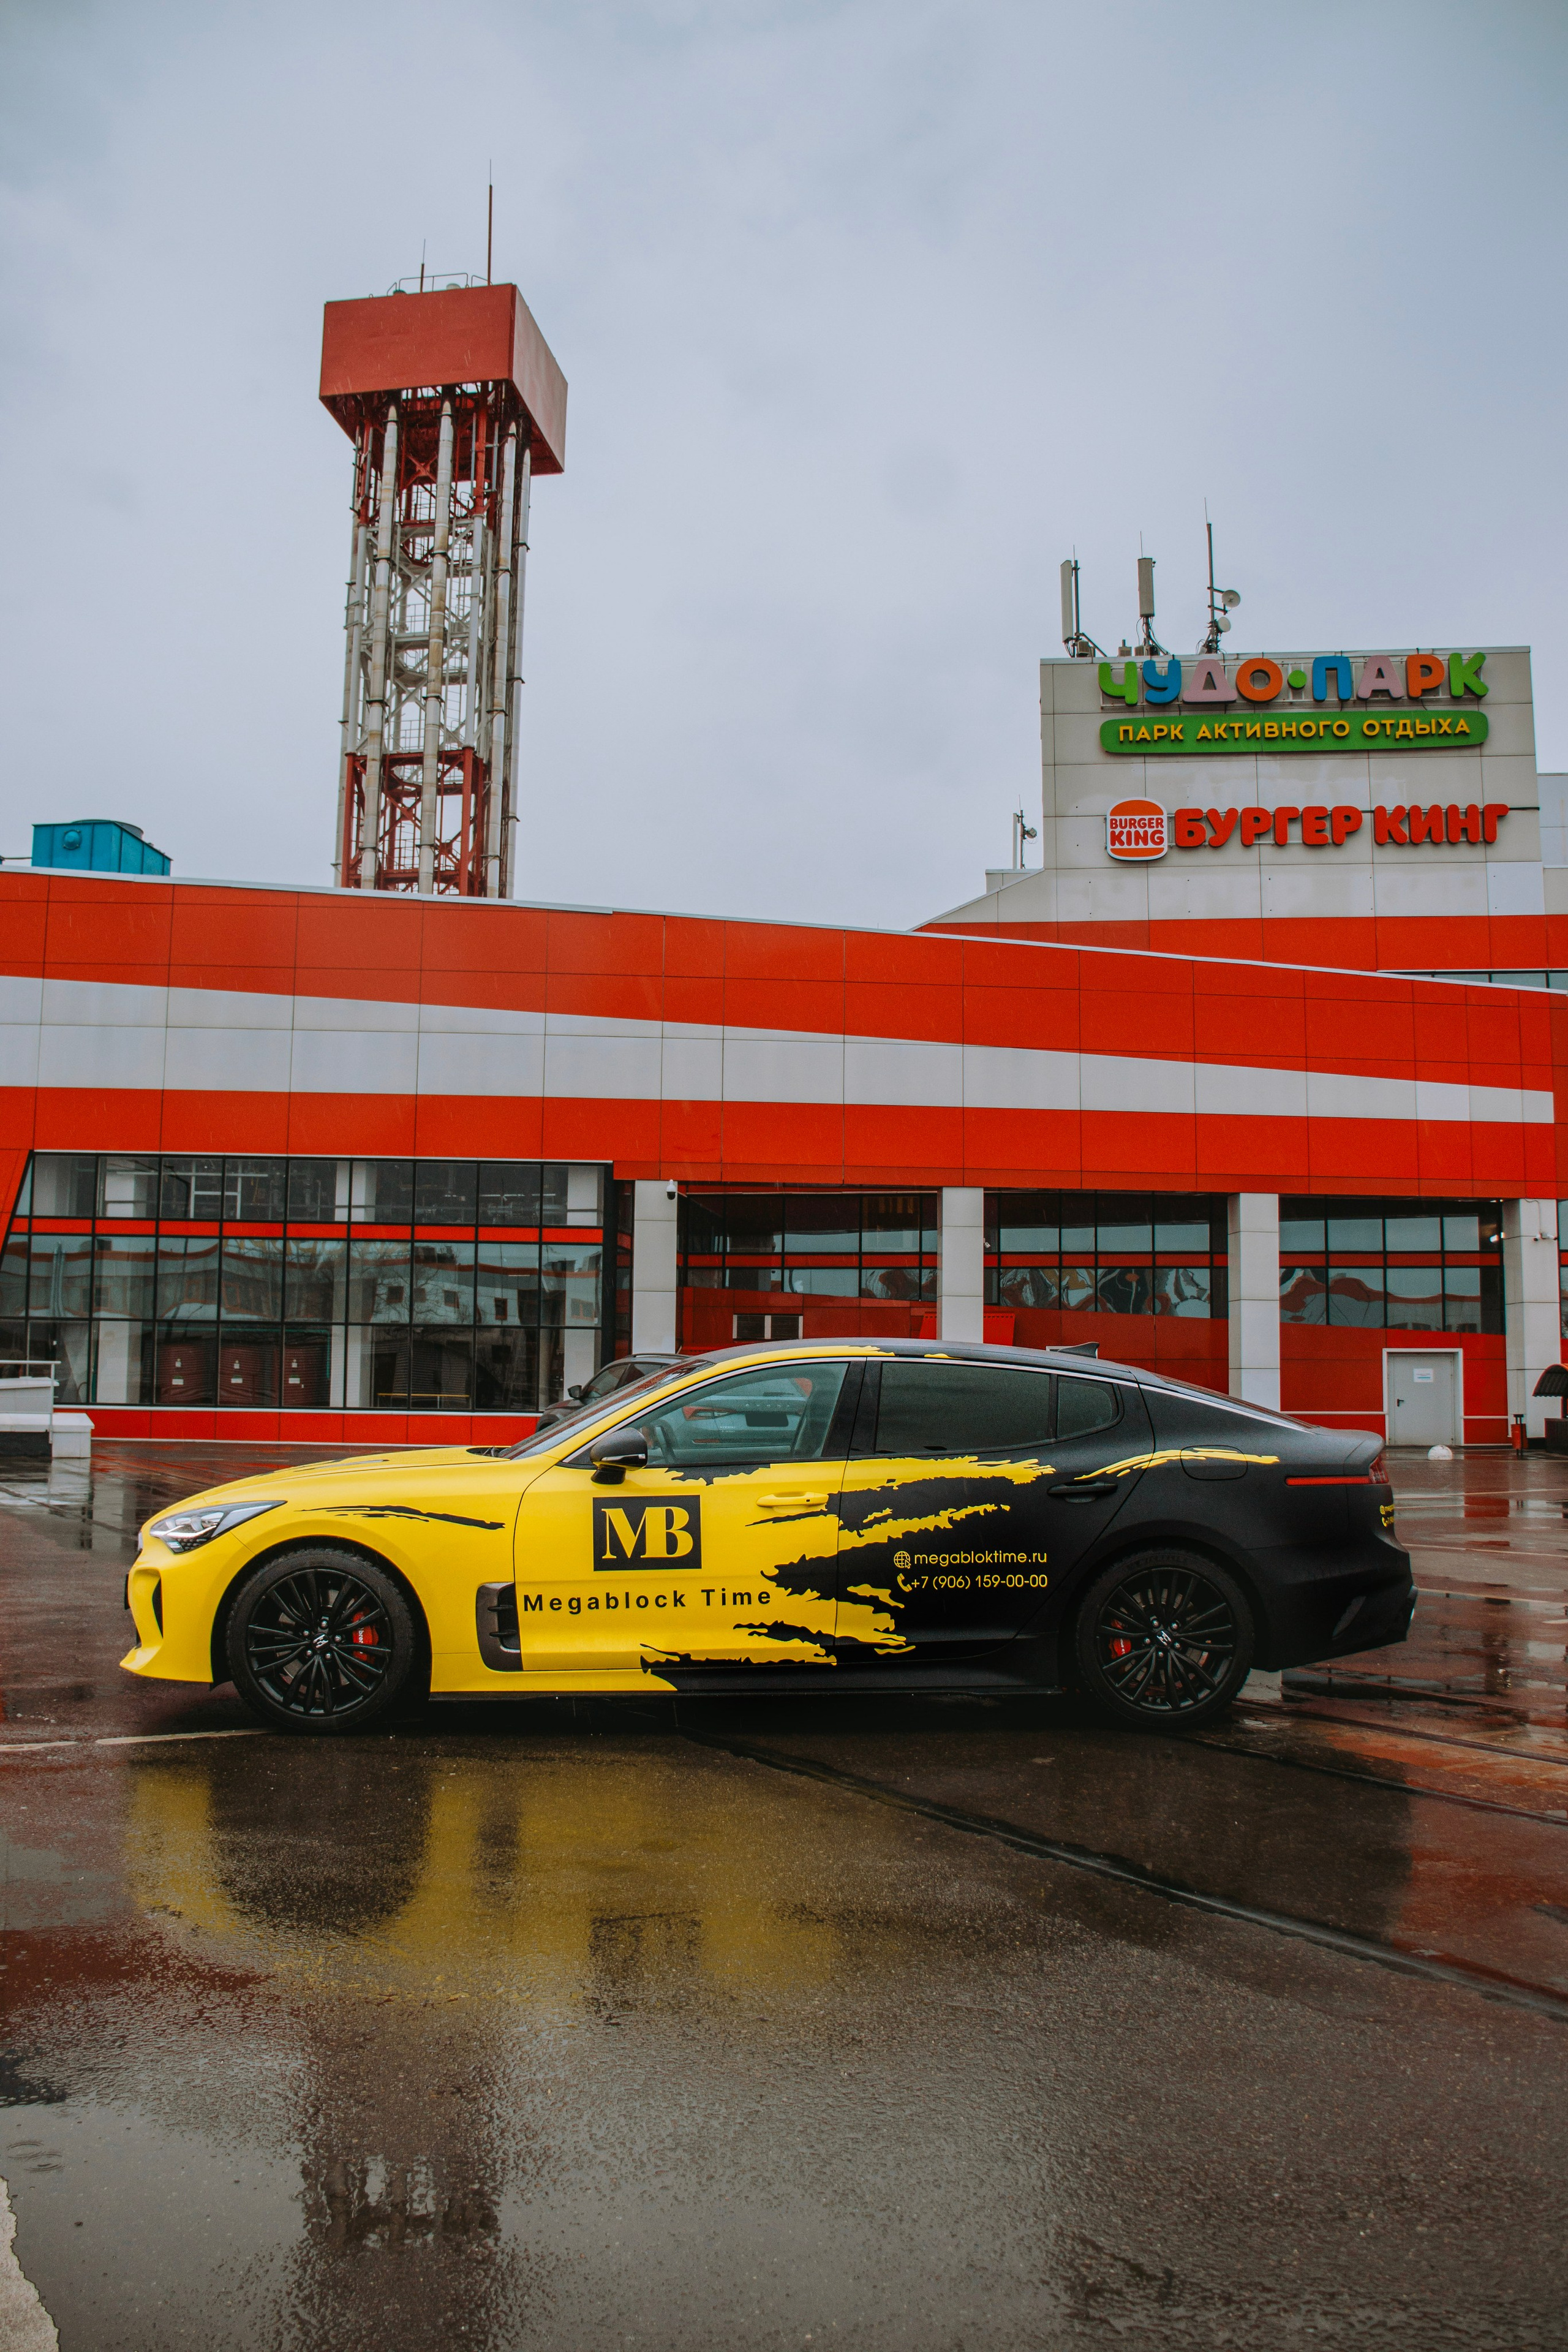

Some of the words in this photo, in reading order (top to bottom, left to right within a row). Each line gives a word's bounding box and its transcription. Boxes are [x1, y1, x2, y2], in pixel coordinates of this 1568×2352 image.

[1119, 724, 1185, 742] ПАРК
[1196, 720, 1350, 741] АКТИВНОГО
[1362, 718, 1471, 739] ОТДЫХА
[1110, 817, 1164, 829] BURGER
[1174, 805, 1363, 848] БУРГЕР
[1373, 804, 1510, 845] КИНГ
[1110, 829, 1164, 846] KING
[601, 1506, 693, 1559] MB
[914, 1550, 1047, 1567] megabloktime.ru
[911, 1576, 929, 1589] +7
[932, 1575, 971, 1590] (906)
[975, 1574, 1048, 1588] 159-00-00
[523, 1590, 687, 1615] Megablock
[701, 1587, 771, 1607] Time
